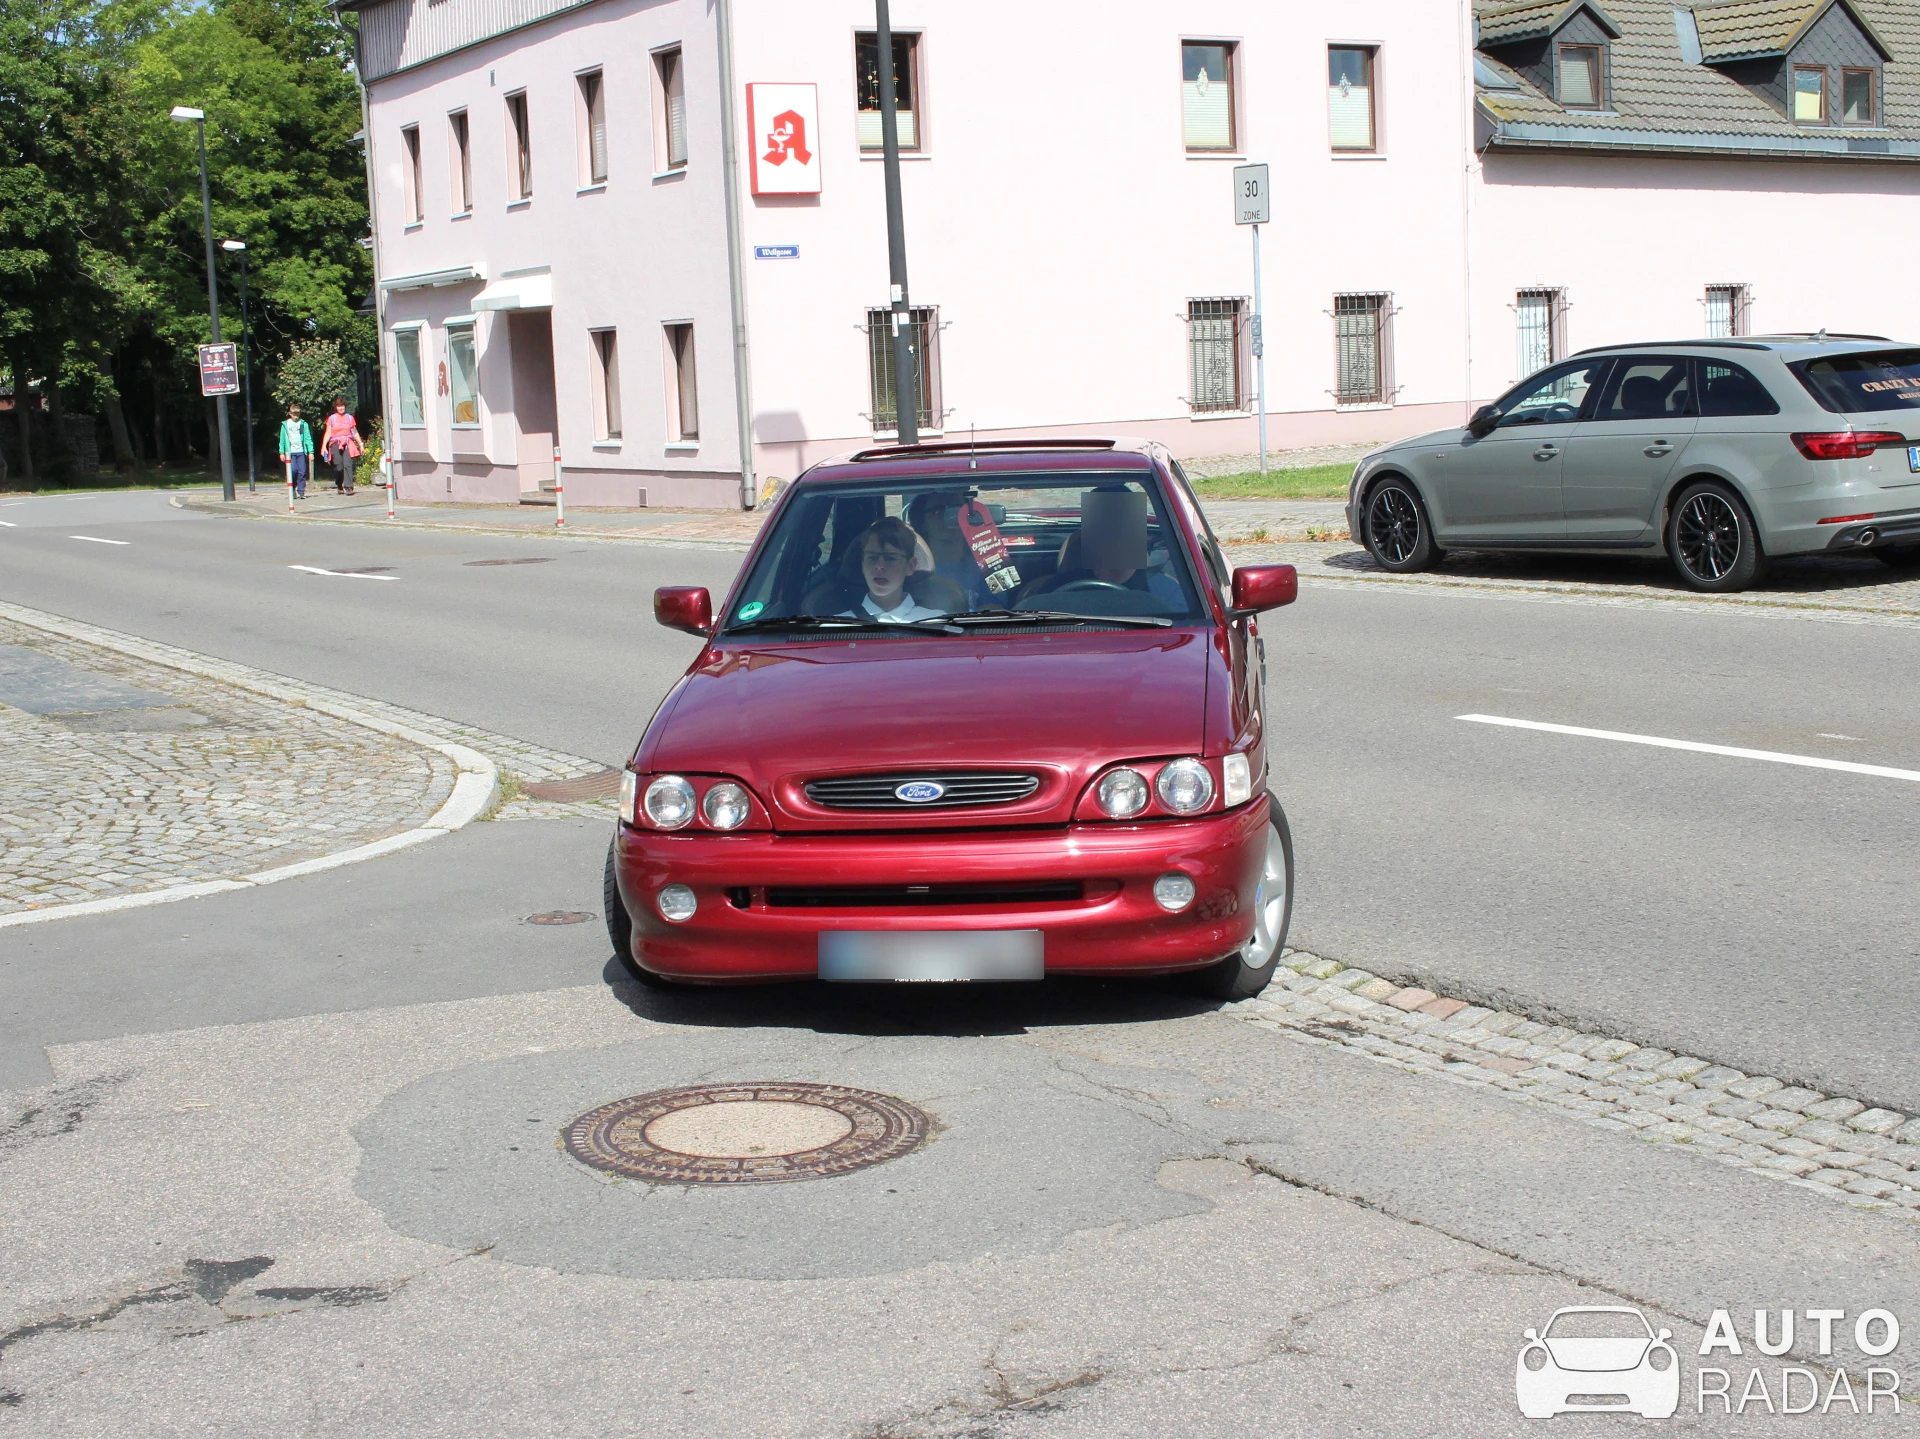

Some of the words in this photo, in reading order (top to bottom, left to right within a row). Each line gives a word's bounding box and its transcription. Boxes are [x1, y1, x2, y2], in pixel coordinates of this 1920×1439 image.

[1244, 180, 1258, 198] 30
[1243, 210, 1261, 221] ZONE
[1861, 378, 1909, 392] CRAZY
[906, 785, 933, 797] Ford
